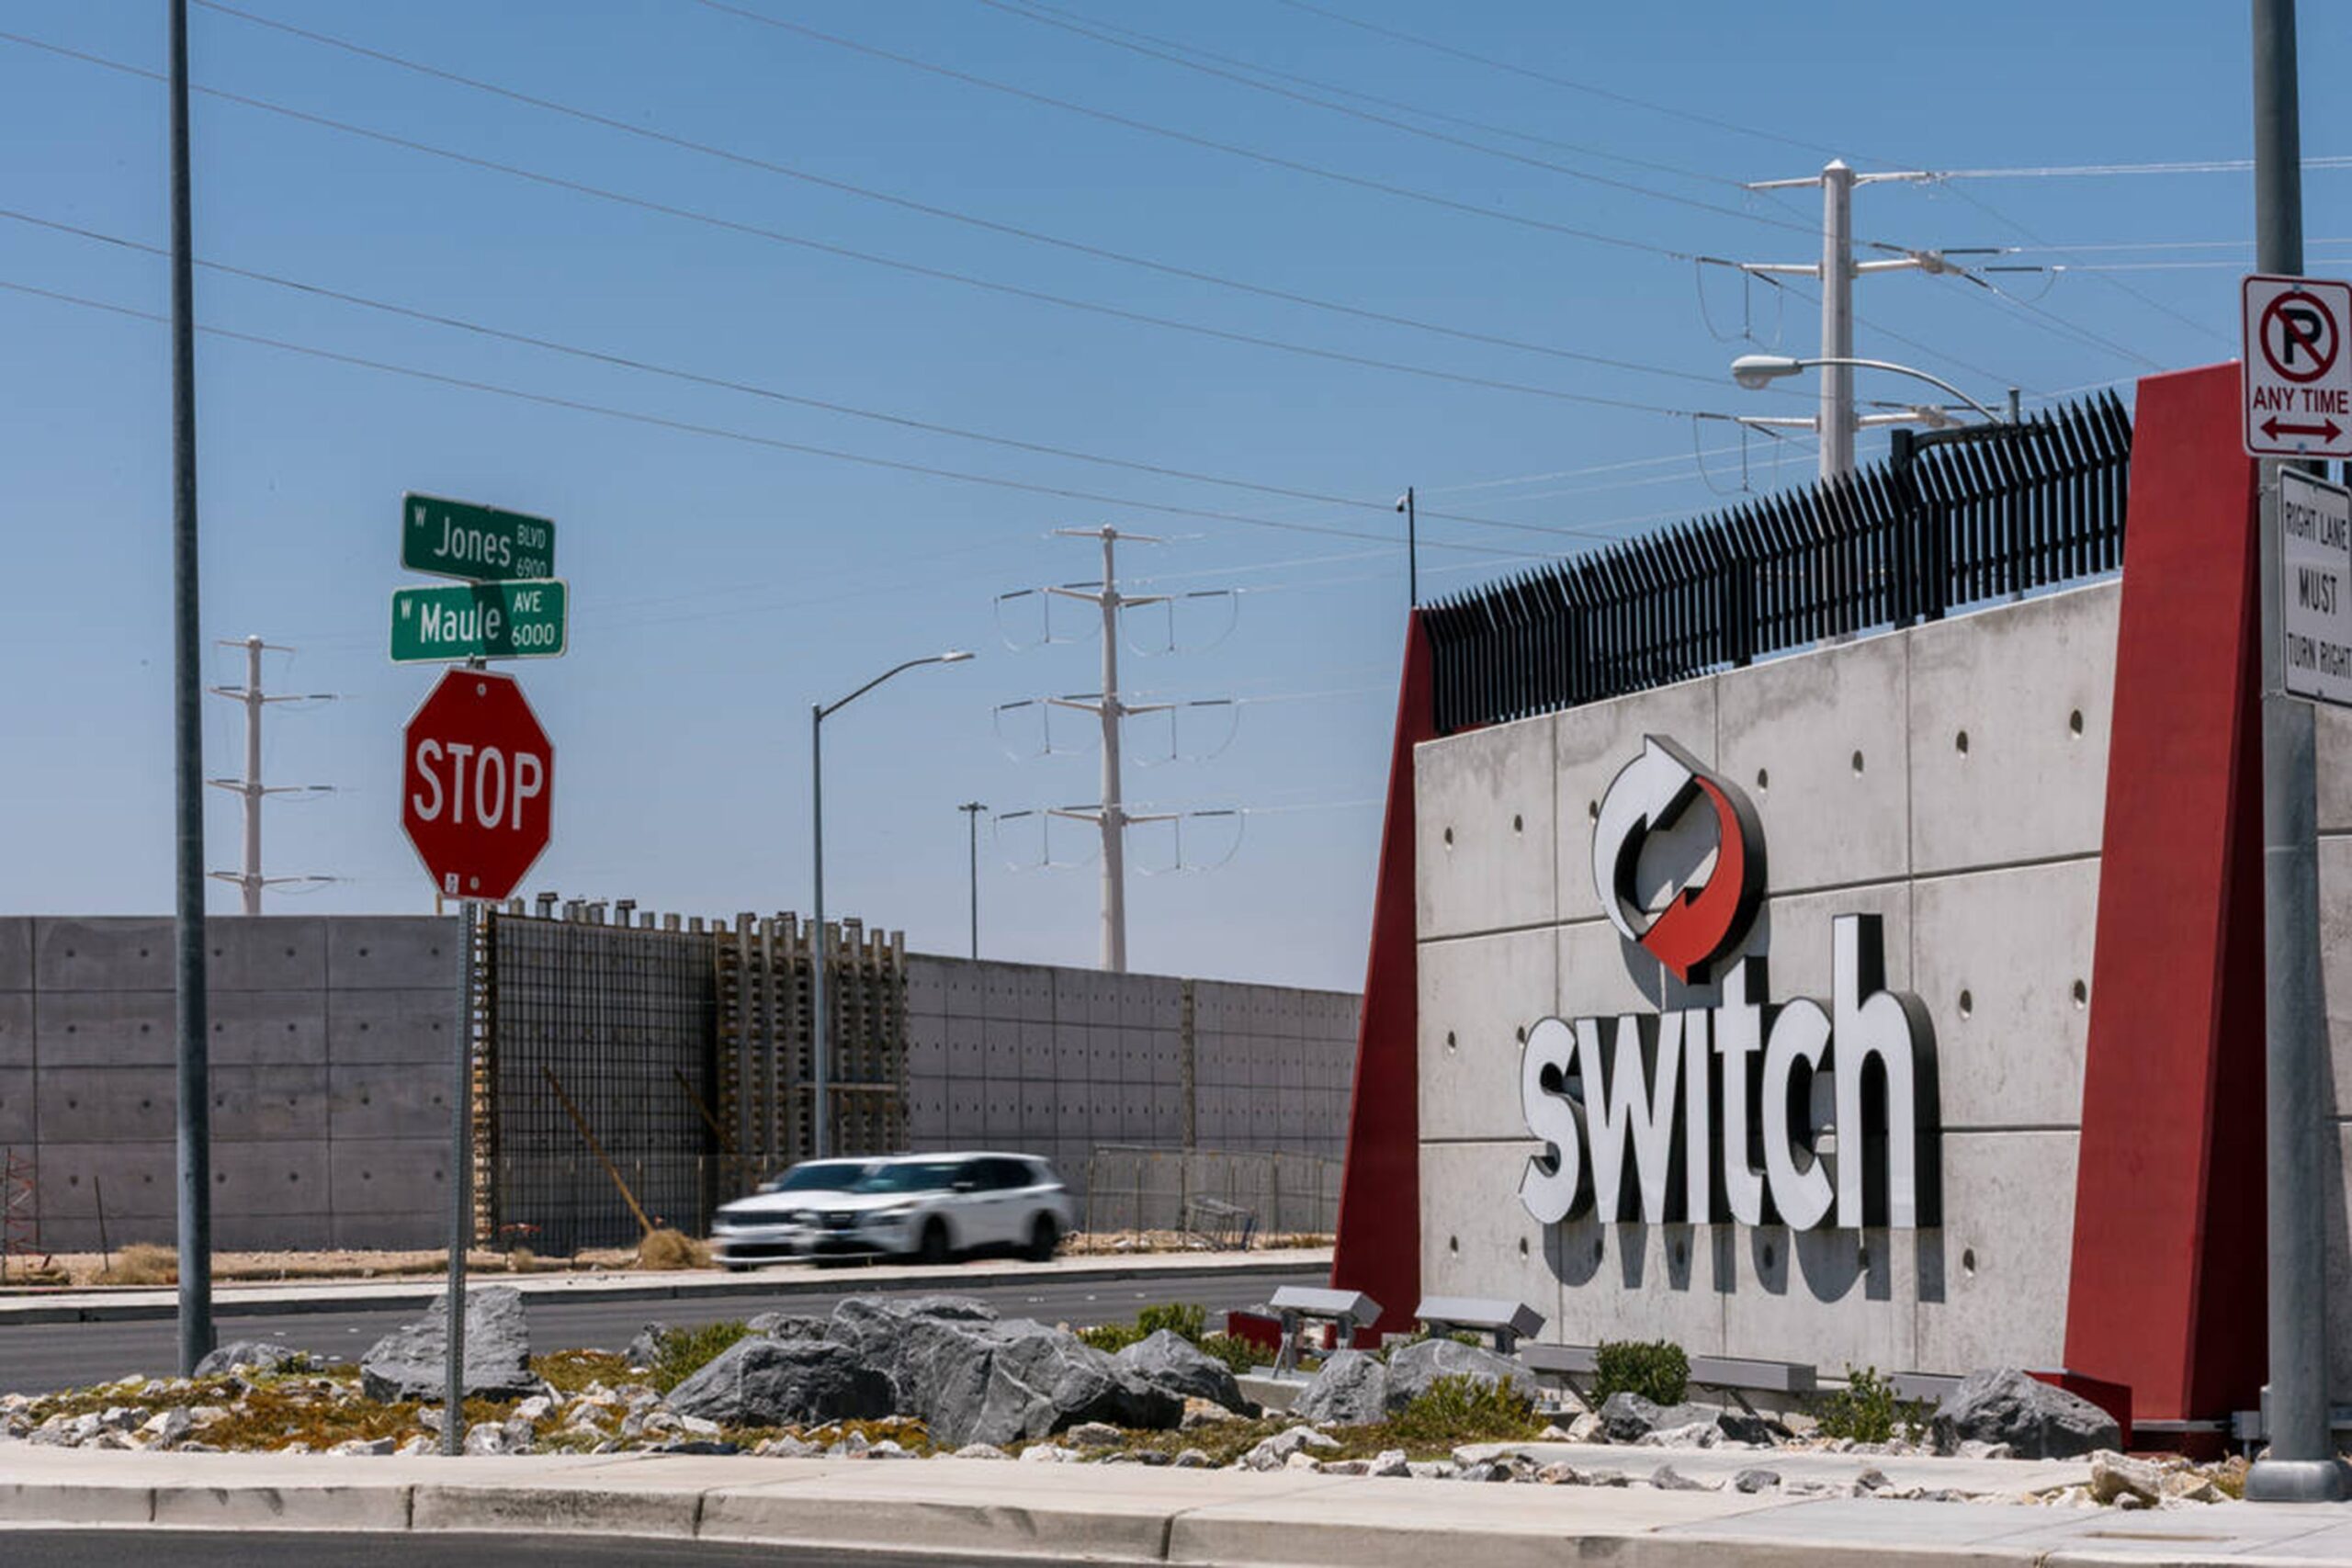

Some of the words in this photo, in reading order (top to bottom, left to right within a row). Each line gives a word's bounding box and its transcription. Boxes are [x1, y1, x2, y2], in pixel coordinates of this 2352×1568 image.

[2253, 386, 2294, 411] ANY
[2301, 389, 2348, 414] TIME
[414, 506, 426, 527] W
[434, 516, 511, 568] Jones
[516, 525, 546, 549] BLVD
[2286, 501, 2316, 542] RIGHT
[2320, 512, 2347, 551] LANE
[513, 591, 543, 613] AVE
[2299, 567, 2336, 615] MUST
[401, 599, 413, 619] W
[420, 601, 501, 643] Maule
[511, 624, 555, 647] 6000
[2288, 632, 2316, 670] TURN
[2320, 641, 2352, 678] RIGHT
[413, 739, 543, 830] STOP
[1519, 913, 1941, 1232] switch
